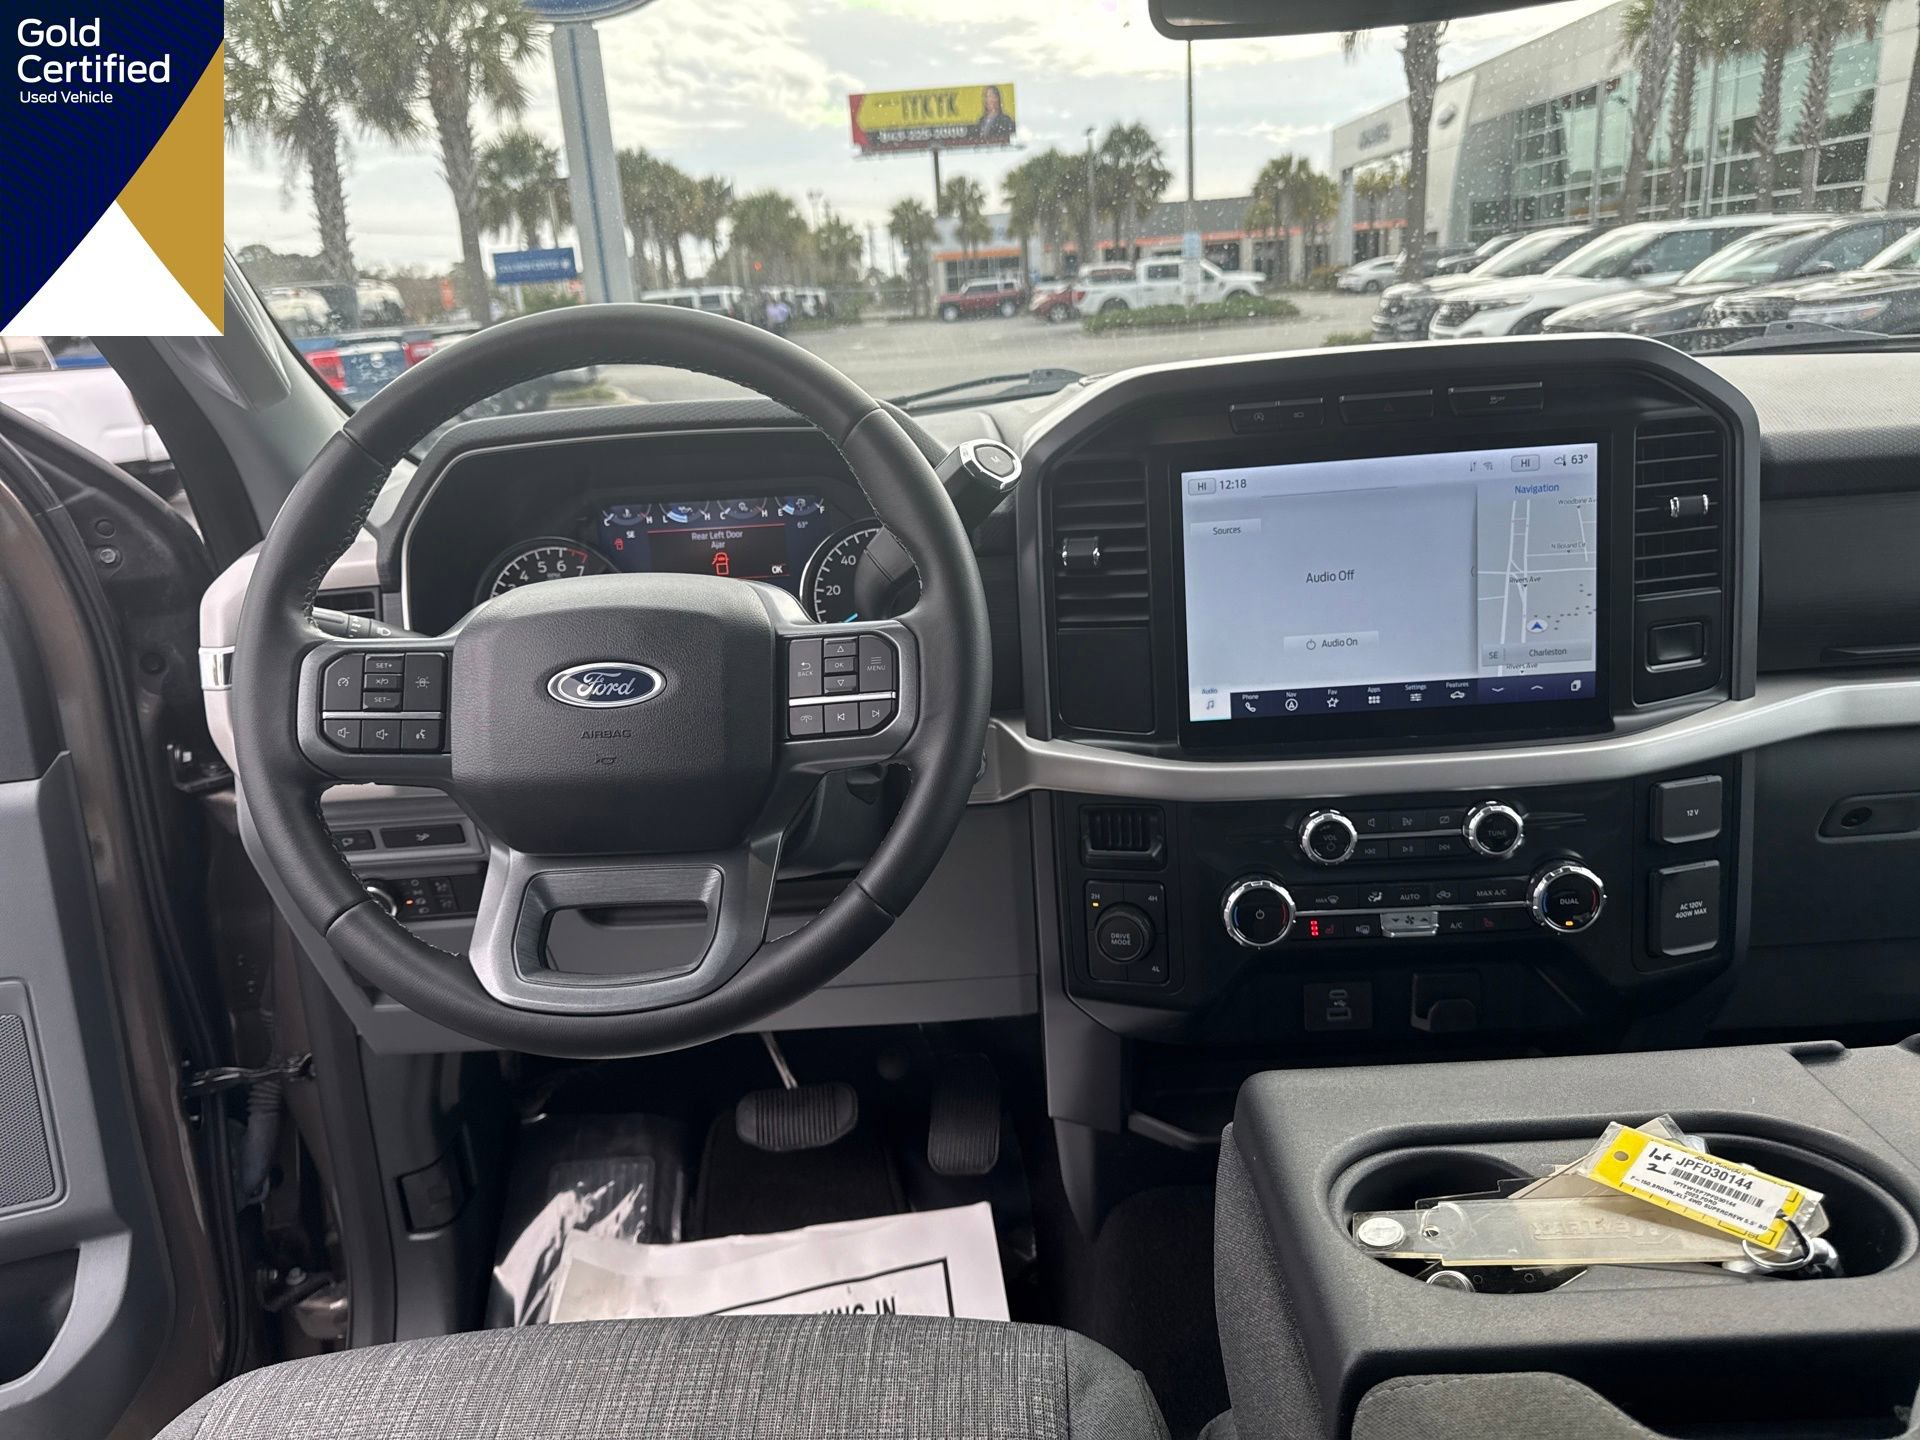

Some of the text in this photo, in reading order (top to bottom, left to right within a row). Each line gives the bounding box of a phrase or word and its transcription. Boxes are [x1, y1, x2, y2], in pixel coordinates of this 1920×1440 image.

[1521, 459, 1530, 467] HI
[1197, 479, 1247, 491] HI 12:18
[1514, 484, 1560, 495] Navigation
[626, 531, 636, 539] SE
[691, 530, 743, 541] Rear Left Door
[1212, 526, 1241, 535] Sources
[711, 541, 726, 550] Ajar
[840, 555, 857, 566] 40
[537, 561, 547, 573] 5
[556, 560, 567, 572] 6
[576, 565, 585, 577] 7
[771, 566, 783, 574] OK
[520, 570, 529, 581] 4
[1306, 569, 1355, 584] Audio Off
[826, 585, 841, 596] 20
[1321, 637, 1358, 649] Audio On
[1489, 651, 1499, 660] SE
[1528, 648, 1567, 657] Charleston
[577, 672, 636, 697] Ford
[1405, 683, 1427, 691] Settings
[581, 729, 632, 739] AIRBAG
[1487, 829, 1507, 837] TUNE
[1400, 893, 1420, 901] AUTO
[1494, 888, 1507, 896] A/C
[1680, 900, 1703, 910] AC 120V
[1694, 907, 1707, 916] MAX
[1676, 1157, 1753, 1191] JPFD30144
